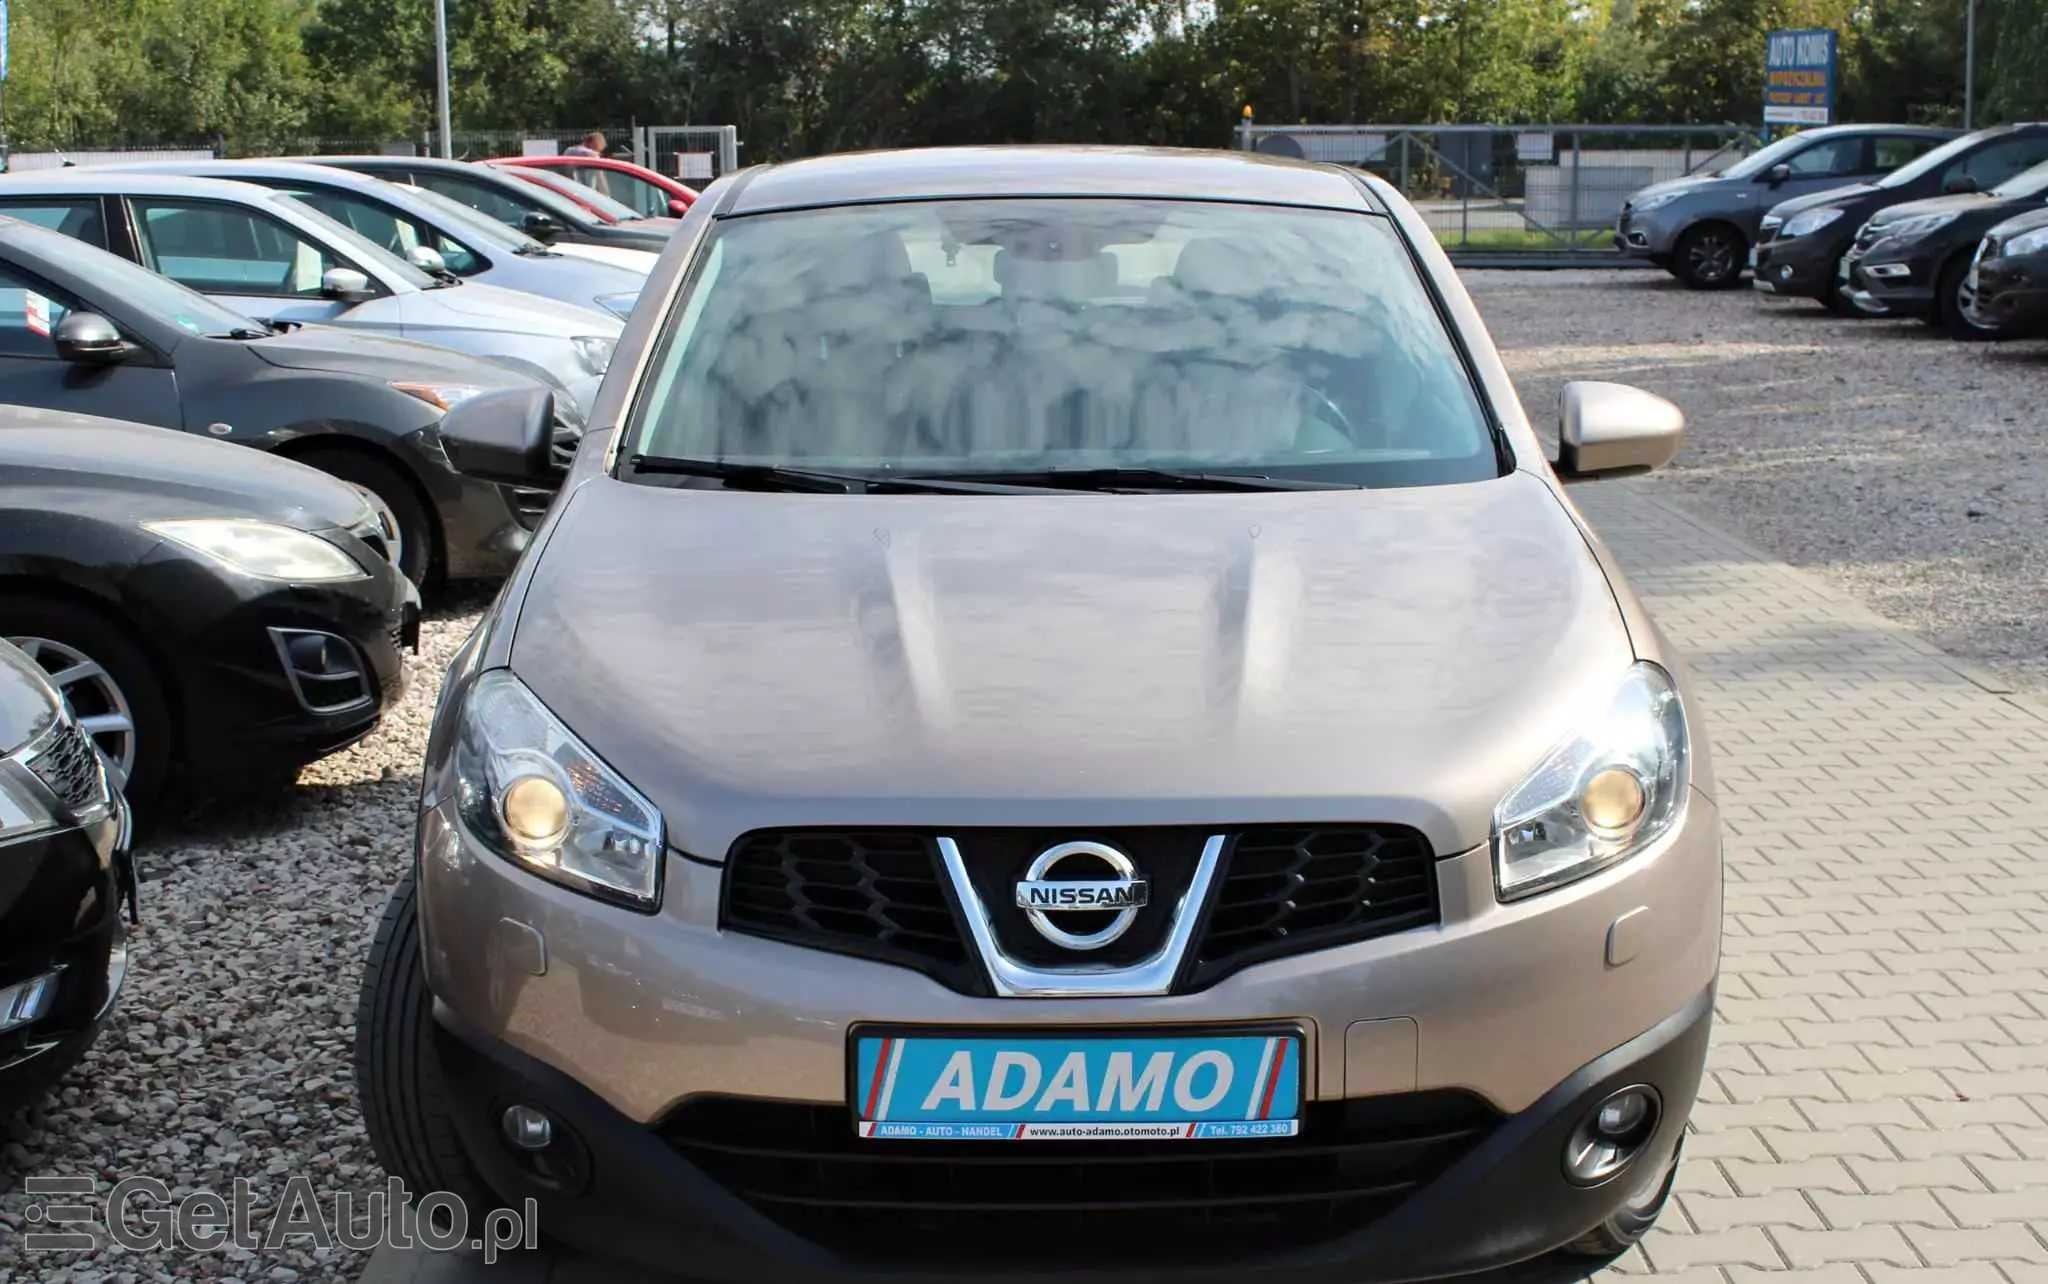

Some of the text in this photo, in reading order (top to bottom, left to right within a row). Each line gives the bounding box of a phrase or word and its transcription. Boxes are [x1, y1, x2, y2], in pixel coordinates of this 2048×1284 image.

[1768, 36, 1795, 67] AUTO
[1030, 887, 1134, 904] NISSAN
[921, 1049, 1235, 1112] ADAMO
[880, 1126, 917, 1136] ADAMO
[925, 1126, 953, 1136] AUTO
[961, 1126, 1002, 1137] HANDEL
[1030, 1126, 1180, 1138] www.auto-adamo.otomoto.pl
[1231, 1125, 1248, 1135] 792
[1250, 1124, 1268, 1134] 422
